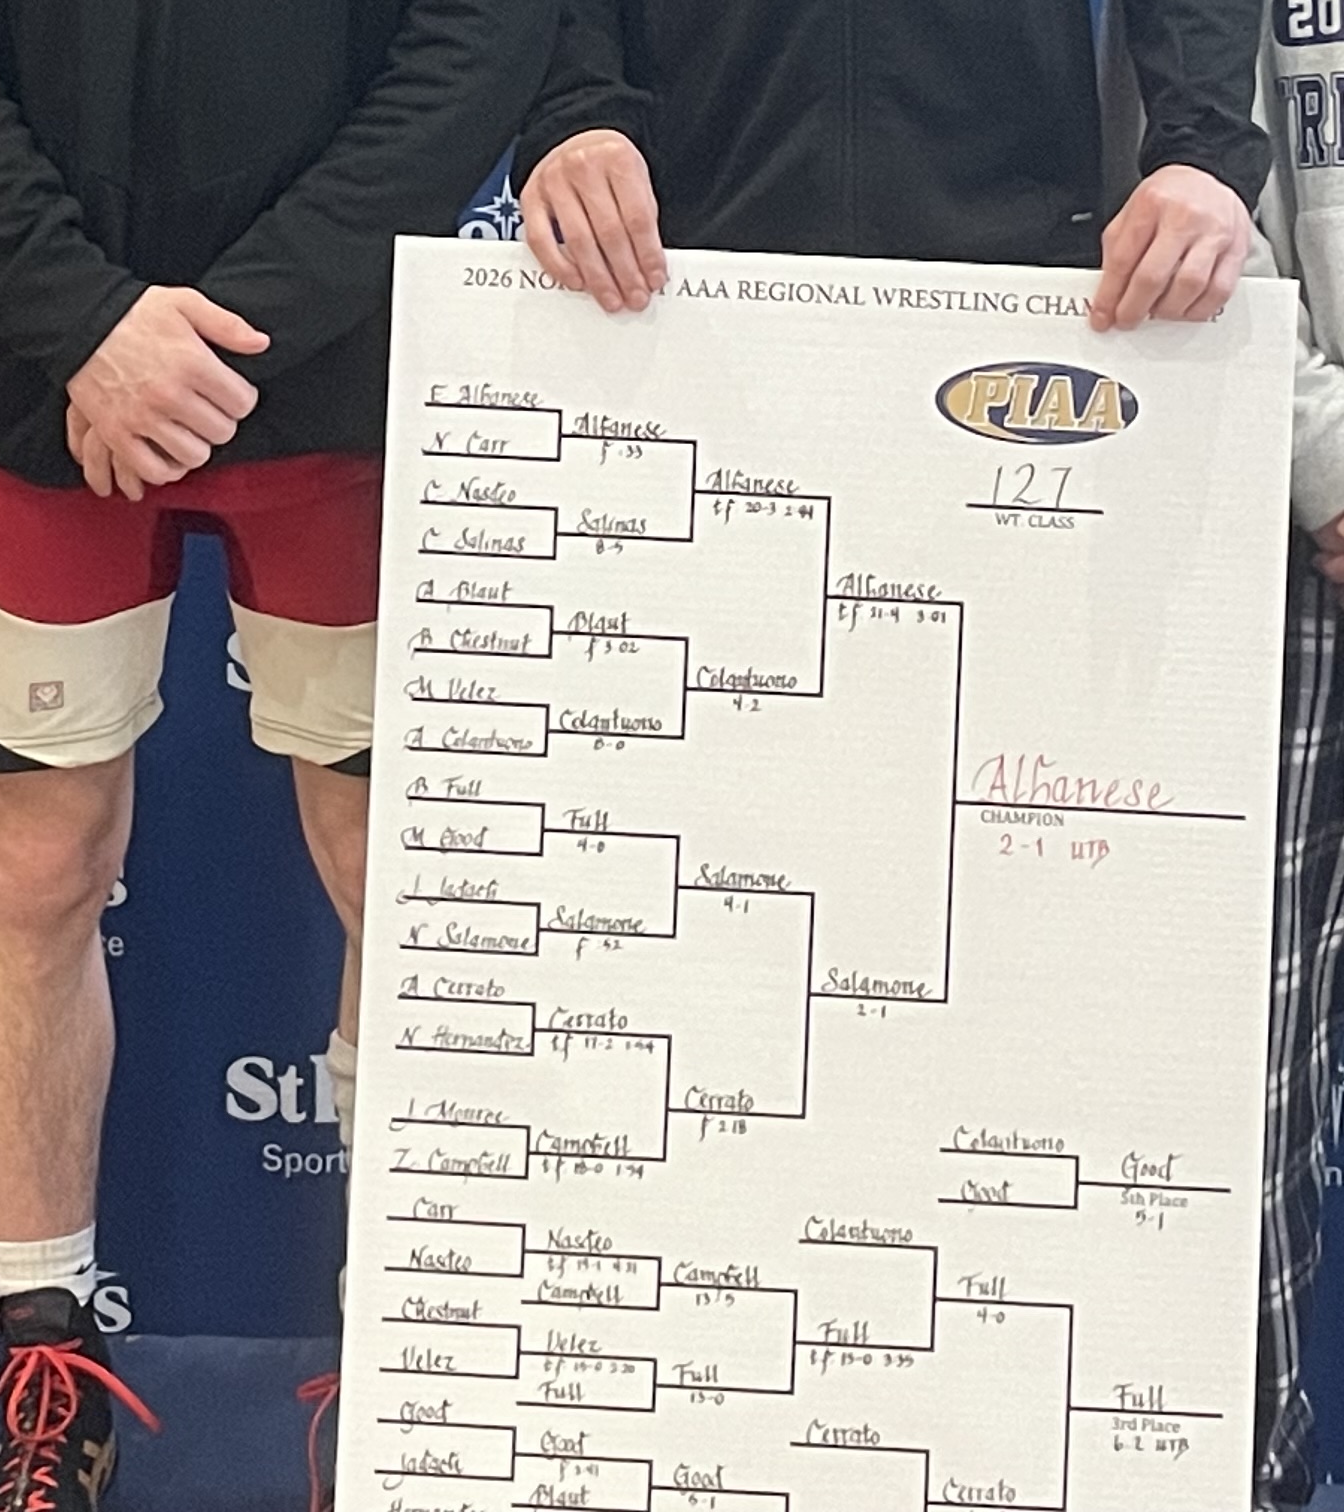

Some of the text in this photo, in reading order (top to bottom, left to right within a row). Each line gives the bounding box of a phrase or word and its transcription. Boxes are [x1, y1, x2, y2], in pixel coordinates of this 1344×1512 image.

[462, 268, 513, 289] 2026
[677, 280, 731, 300] AAA
[737, 281, 865, 306] REGIONAL
[873, 287, 1018, 313] WRESTLING
[965, 372, 1126, 432] PIAA
[573, 413, 667, 439] Albanese
[465, 432, 511, 455] Carr
[706, 468, 800, 496] Albanese
[993, 463, 1074, 508] 127
[576, 508, 649, 535] Salinas
[1028, 514, 1074, 529] CLASS
[454, 528, 526, 553] Salinas
[836, 572, 943, 600] Albanese
[450, 630, 533, 653] Chestnut
[448, 679, 500, 701] Velez
[696, 667, 798, 690] Colantuono
[559, 708, 662, 733] Colantuono
[444, 777, 483, 797] Full
[971, 753, 1175, 811] Albanese
[562, 809, 611, 829] Full
[981, 810, 1064, 826] CHAMPION
[999, 833, 1044, 858] 2-1
[694, 863, 791, 891] Salamone
[547, 906, 646, 933] Salamone
[437, 924, 530, 950] Salamone
[433, 977, 506, 999] Cerrato
[821, 967, 933, 998] Salamone
[548, 1007, 629, 1030] Cerrato
[684, 1085, 755, 1112] Cerrato
[535, 1132, 631, 1158] Campbell
[263, 1144, 348, 1177] Sport
[428, 1151, 511, 1184] Campbell
[1120, 1151, 1182, 1188] Good
[412, 1196, 459, 1220] Carr
[1149, 1192, 1188, 1207] Place
[673, 1262, 761, 1297] Campbell
[957, 1272, 1009, 1300] Full
[546, 1330, 603, 1353] Velez
[818, 1321, 871, 1344] Full
[401, 1346, 457, 1371] Velez
[672, 1363, 720, 1385] Full
[538, 1379, 585, 1402] Full
[1113, 1383, 1168, 1411] Full
[806, 1419, 881, 1446] Cerrato
[1111, 1416, 1181, 1433] 3rd Place
[941, 1478, 1016, 1504] Cerrato
